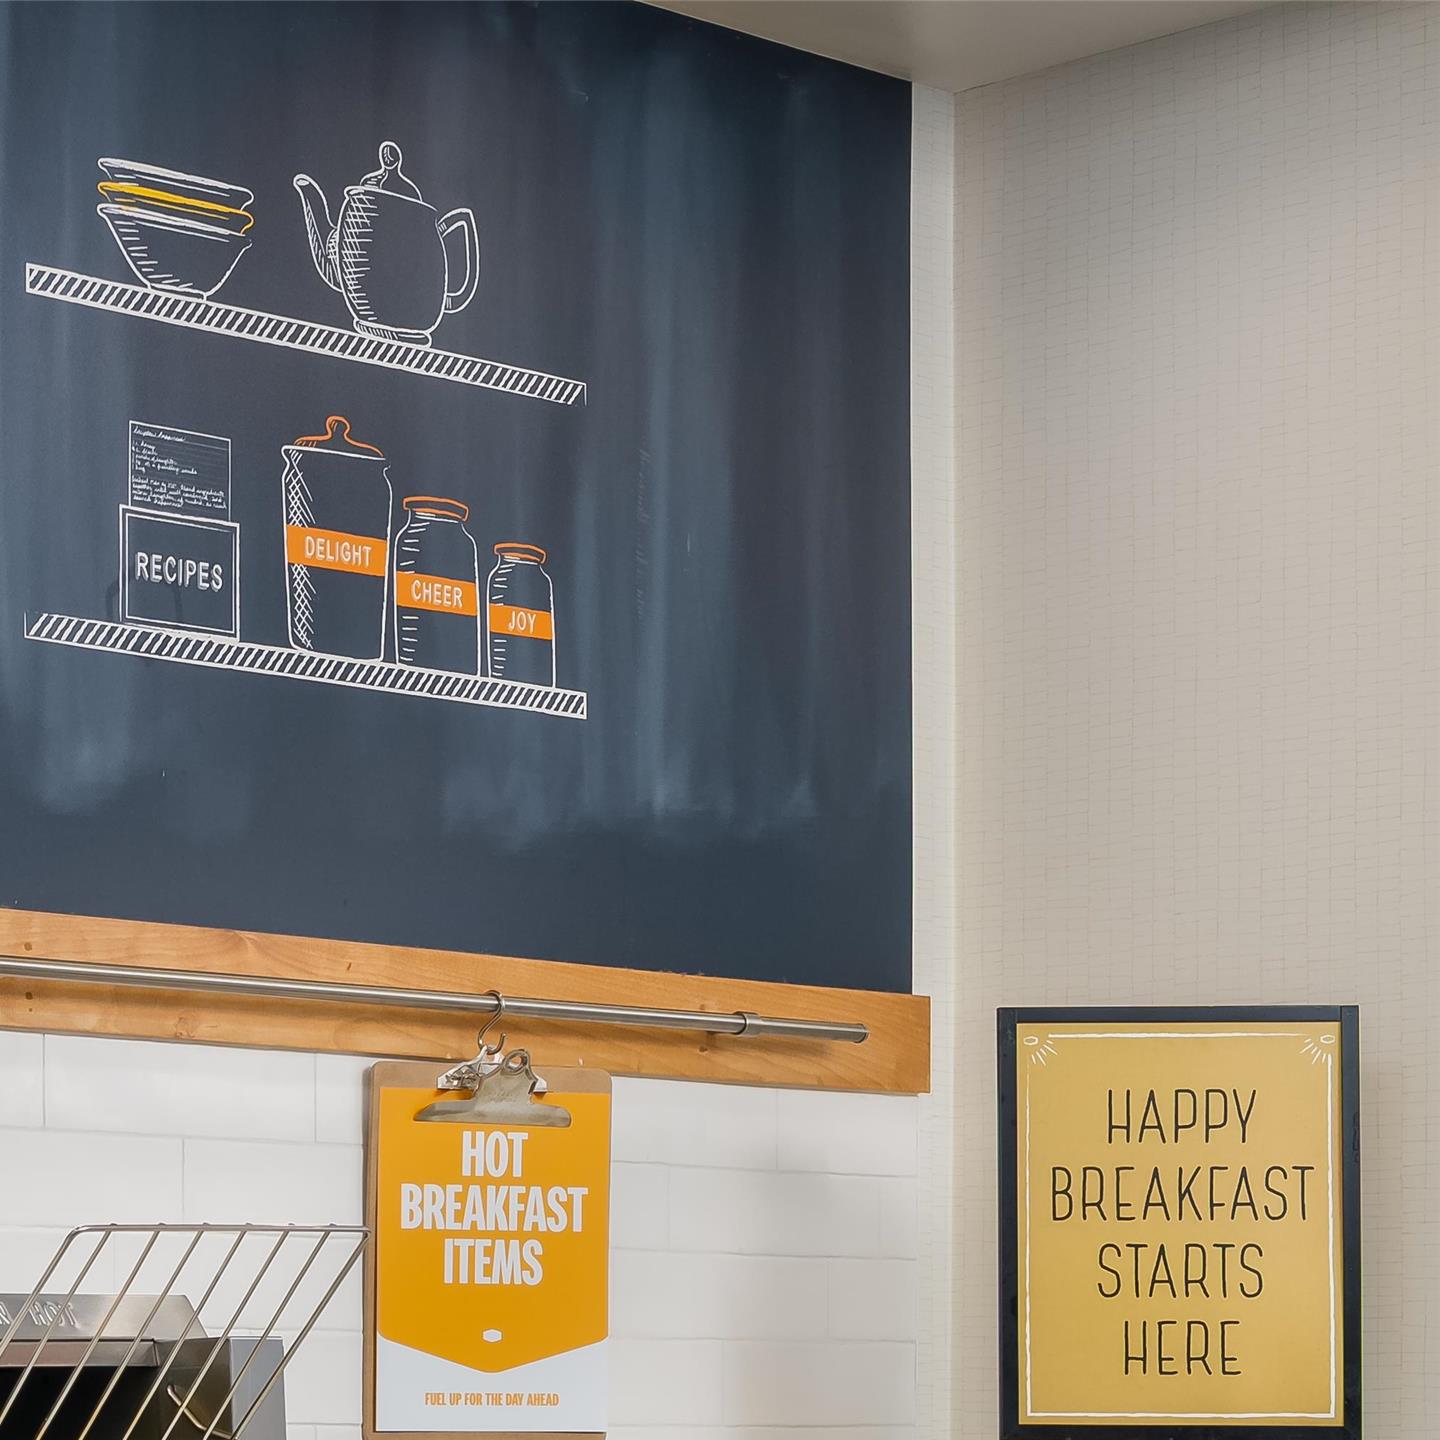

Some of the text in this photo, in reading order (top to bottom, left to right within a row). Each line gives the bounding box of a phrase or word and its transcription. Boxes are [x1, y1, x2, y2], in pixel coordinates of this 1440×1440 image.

[135, 551, 224, 593] RECIPES
[304, 535, 372, 567] DELIGHT
[410, 581, 464, 609] CHEER
[507, 611, 537, 633] JOY
[1107, 1088, 1257, 1144] HAPPY
[460, 1130, 529, 1178] HOT
[400, 1183, 589, 1233] BREAKFAST
[1051, 1166, 1315, 1222] BREAKFAST
[442, 1238, 544, 1286] ITEMS
[1097, 1243, 1264, 1299] STARTS
[28, 1300, 83, 1330] HOT
[1123, 1319, 1242, 1376] HERE
[424, 1391, 560, 1407] FUEL UP FOR THE DAY AHEAD
